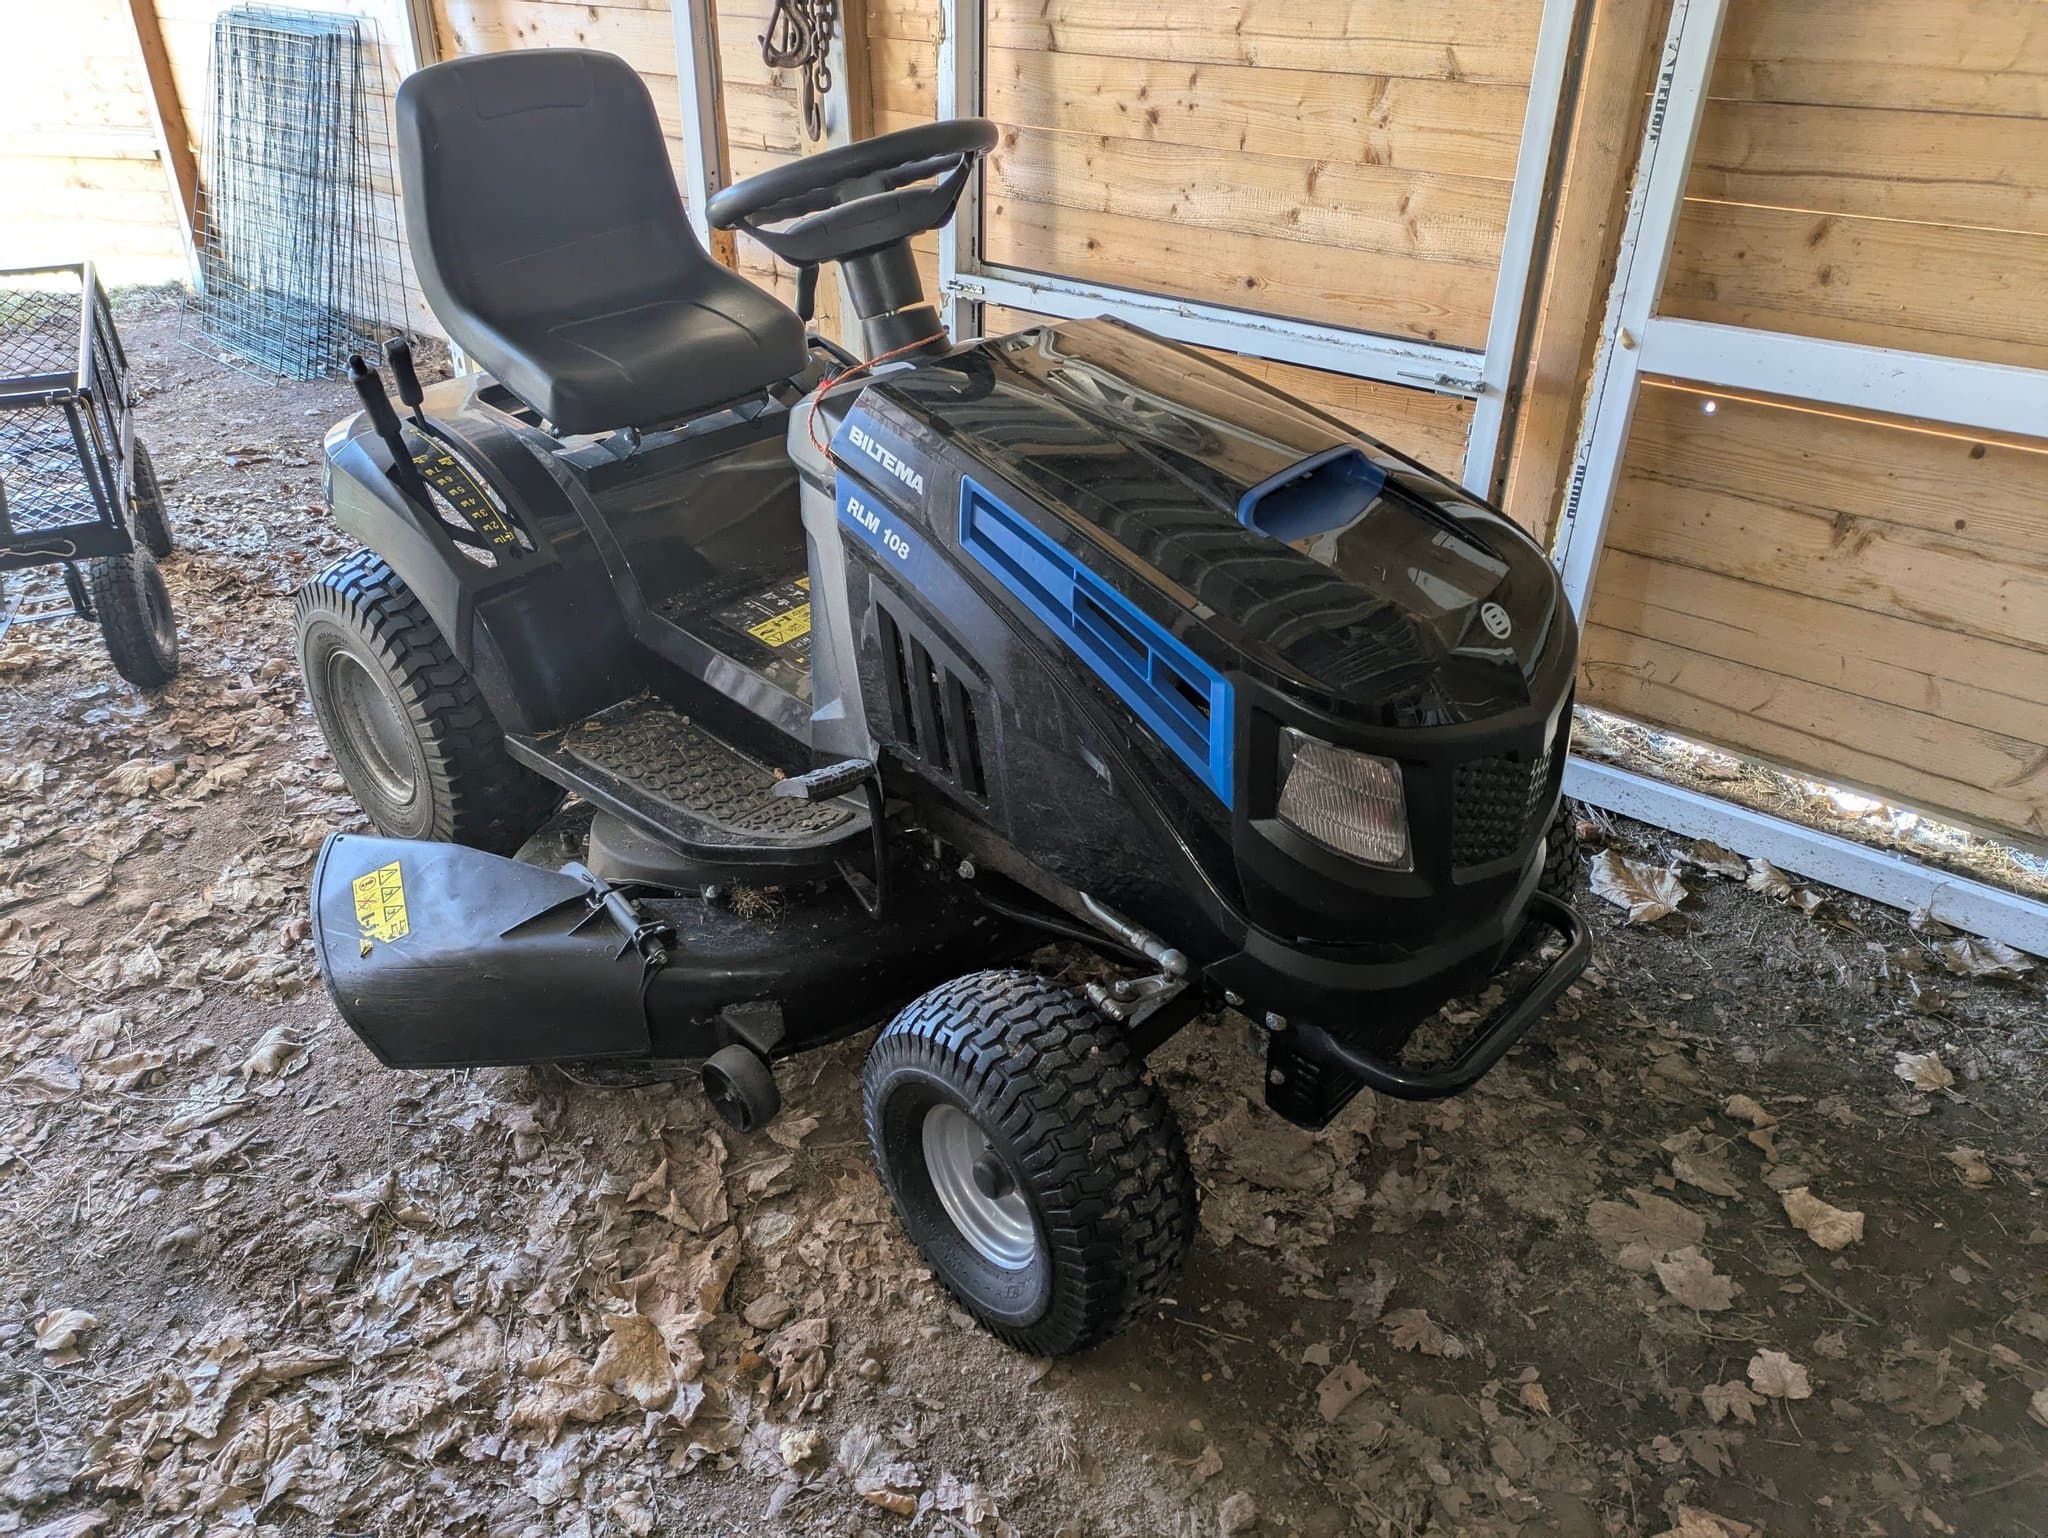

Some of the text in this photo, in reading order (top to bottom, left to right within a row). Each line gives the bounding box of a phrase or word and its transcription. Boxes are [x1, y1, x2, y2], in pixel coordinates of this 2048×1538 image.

[849, 425, 924, 496] BILTEMA
[846, 496, 910, 560] RLM 108
